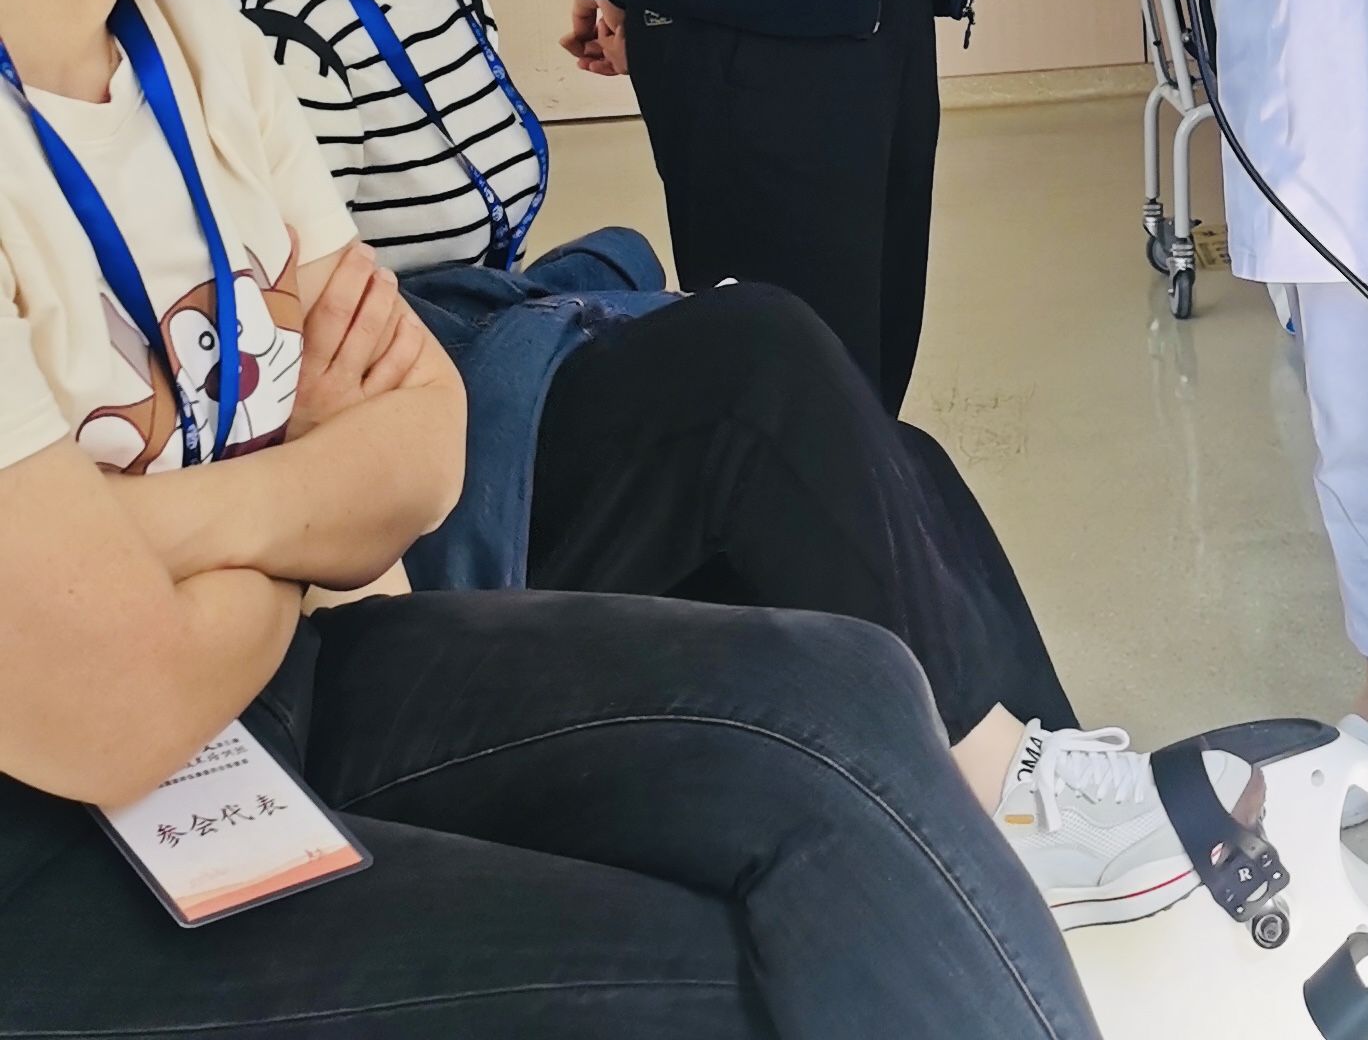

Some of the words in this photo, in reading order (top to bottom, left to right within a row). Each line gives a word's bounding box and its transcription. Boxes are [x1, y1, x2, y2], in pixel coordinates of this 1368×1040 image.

[157, 794, 288, 848] 参会代表
[1238, 867, 1252, 882] R
